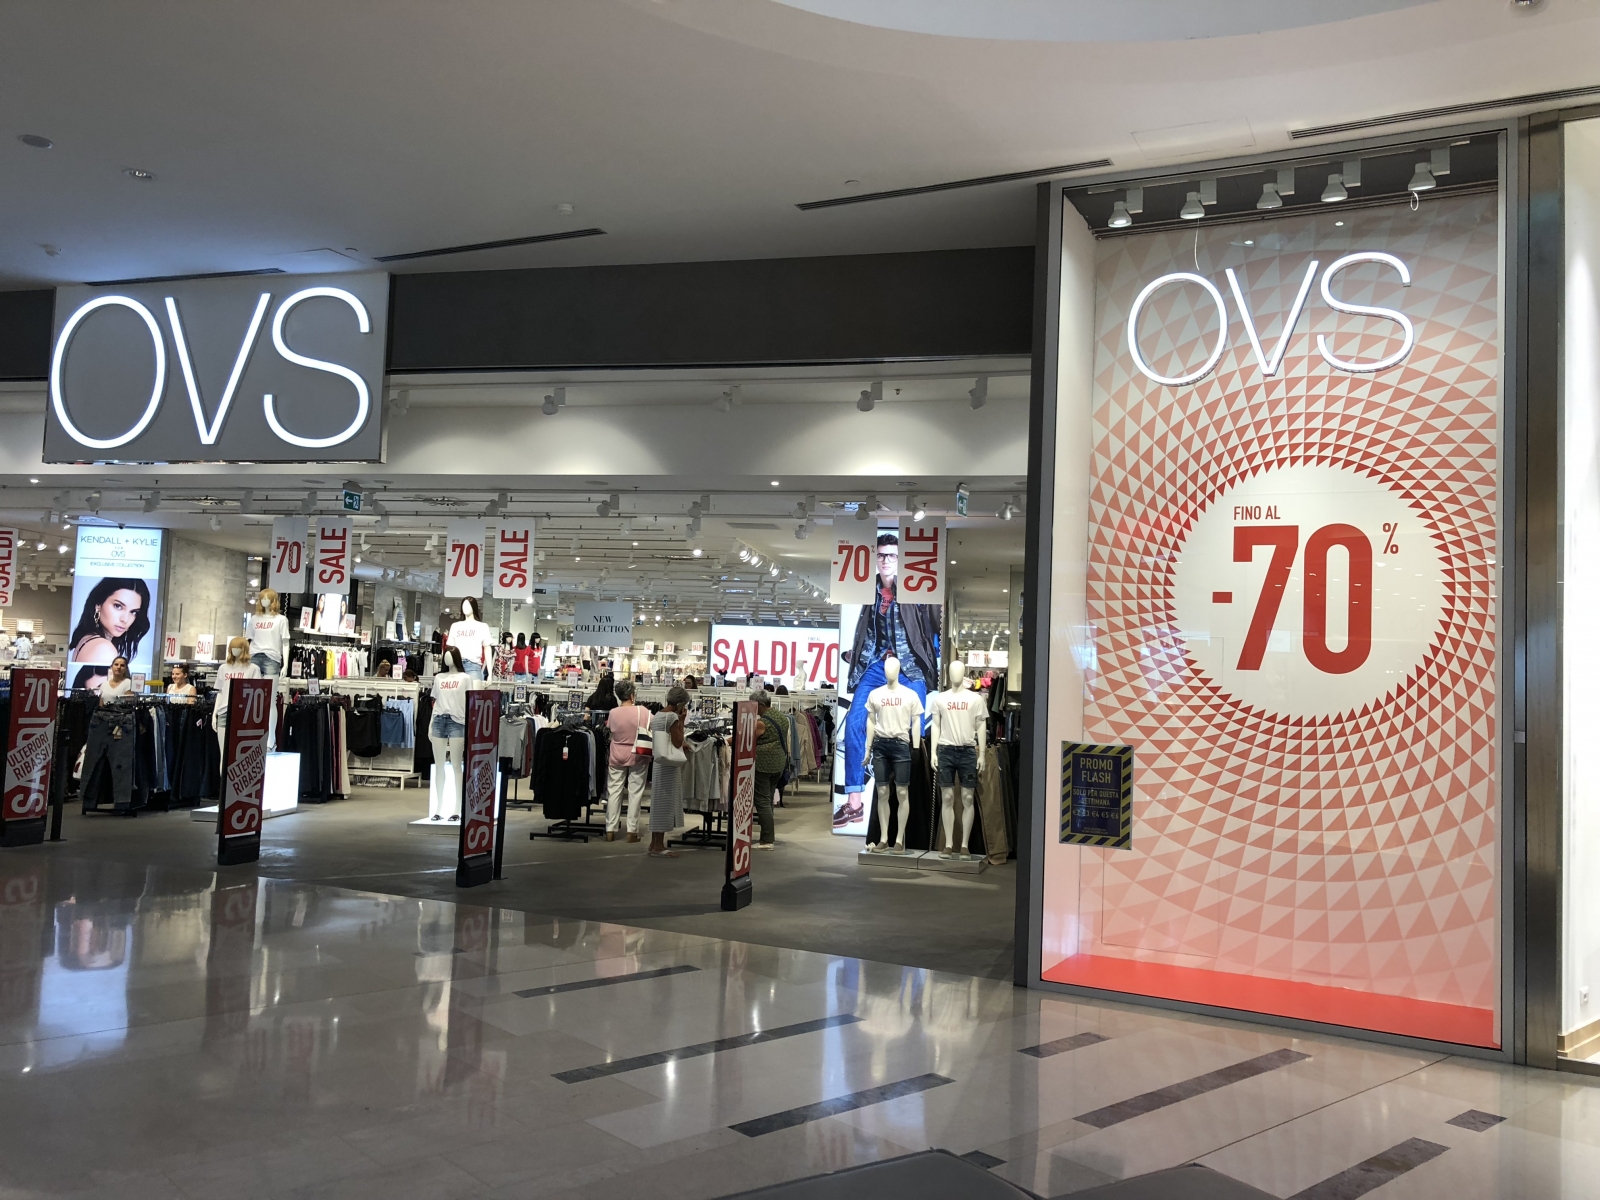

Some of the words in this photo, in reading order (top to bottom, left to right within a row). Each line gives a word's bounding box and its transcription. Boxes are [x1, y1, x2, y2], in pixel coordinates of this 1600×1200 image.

[1127, 251, 1415, 387] OVS
[51, 287, 370, 449] OVS
[1233, 505, 1262, 521] FINO
[1265, 505, 1281, 520] AL
[80, 536, 122, 545] KENDALL
[132, 538, 158, 546] KYLIE
[318, 527, 347, 584] SALE
[498, 529, 529, 588] SALE
[903, 527, 939, 592] SALE
[255, 622, 273, 630] SALDI
[593, 615, 613, 623] NEW
[456, 630, 476, 638] SALDI
[575, 624, 630, 633] COLLECTION
[712, 638, 797, 676] SALDI
[440, 681, 459, 689] SALDI
[881, 698, 902, 707] SALDI
[947, 702, 968, 711] SALDI
[8, 732, 49, 768] ULTERIORI
[227, 744, 263, 782] ULTERIORI
[1080, 757, 1113, 771] PROMO
[466, 760, 492, 799] ULTERIORI
[1081, 770, 1111, 784] FLASH
[1073, 788, 1086, 796] SOLO
